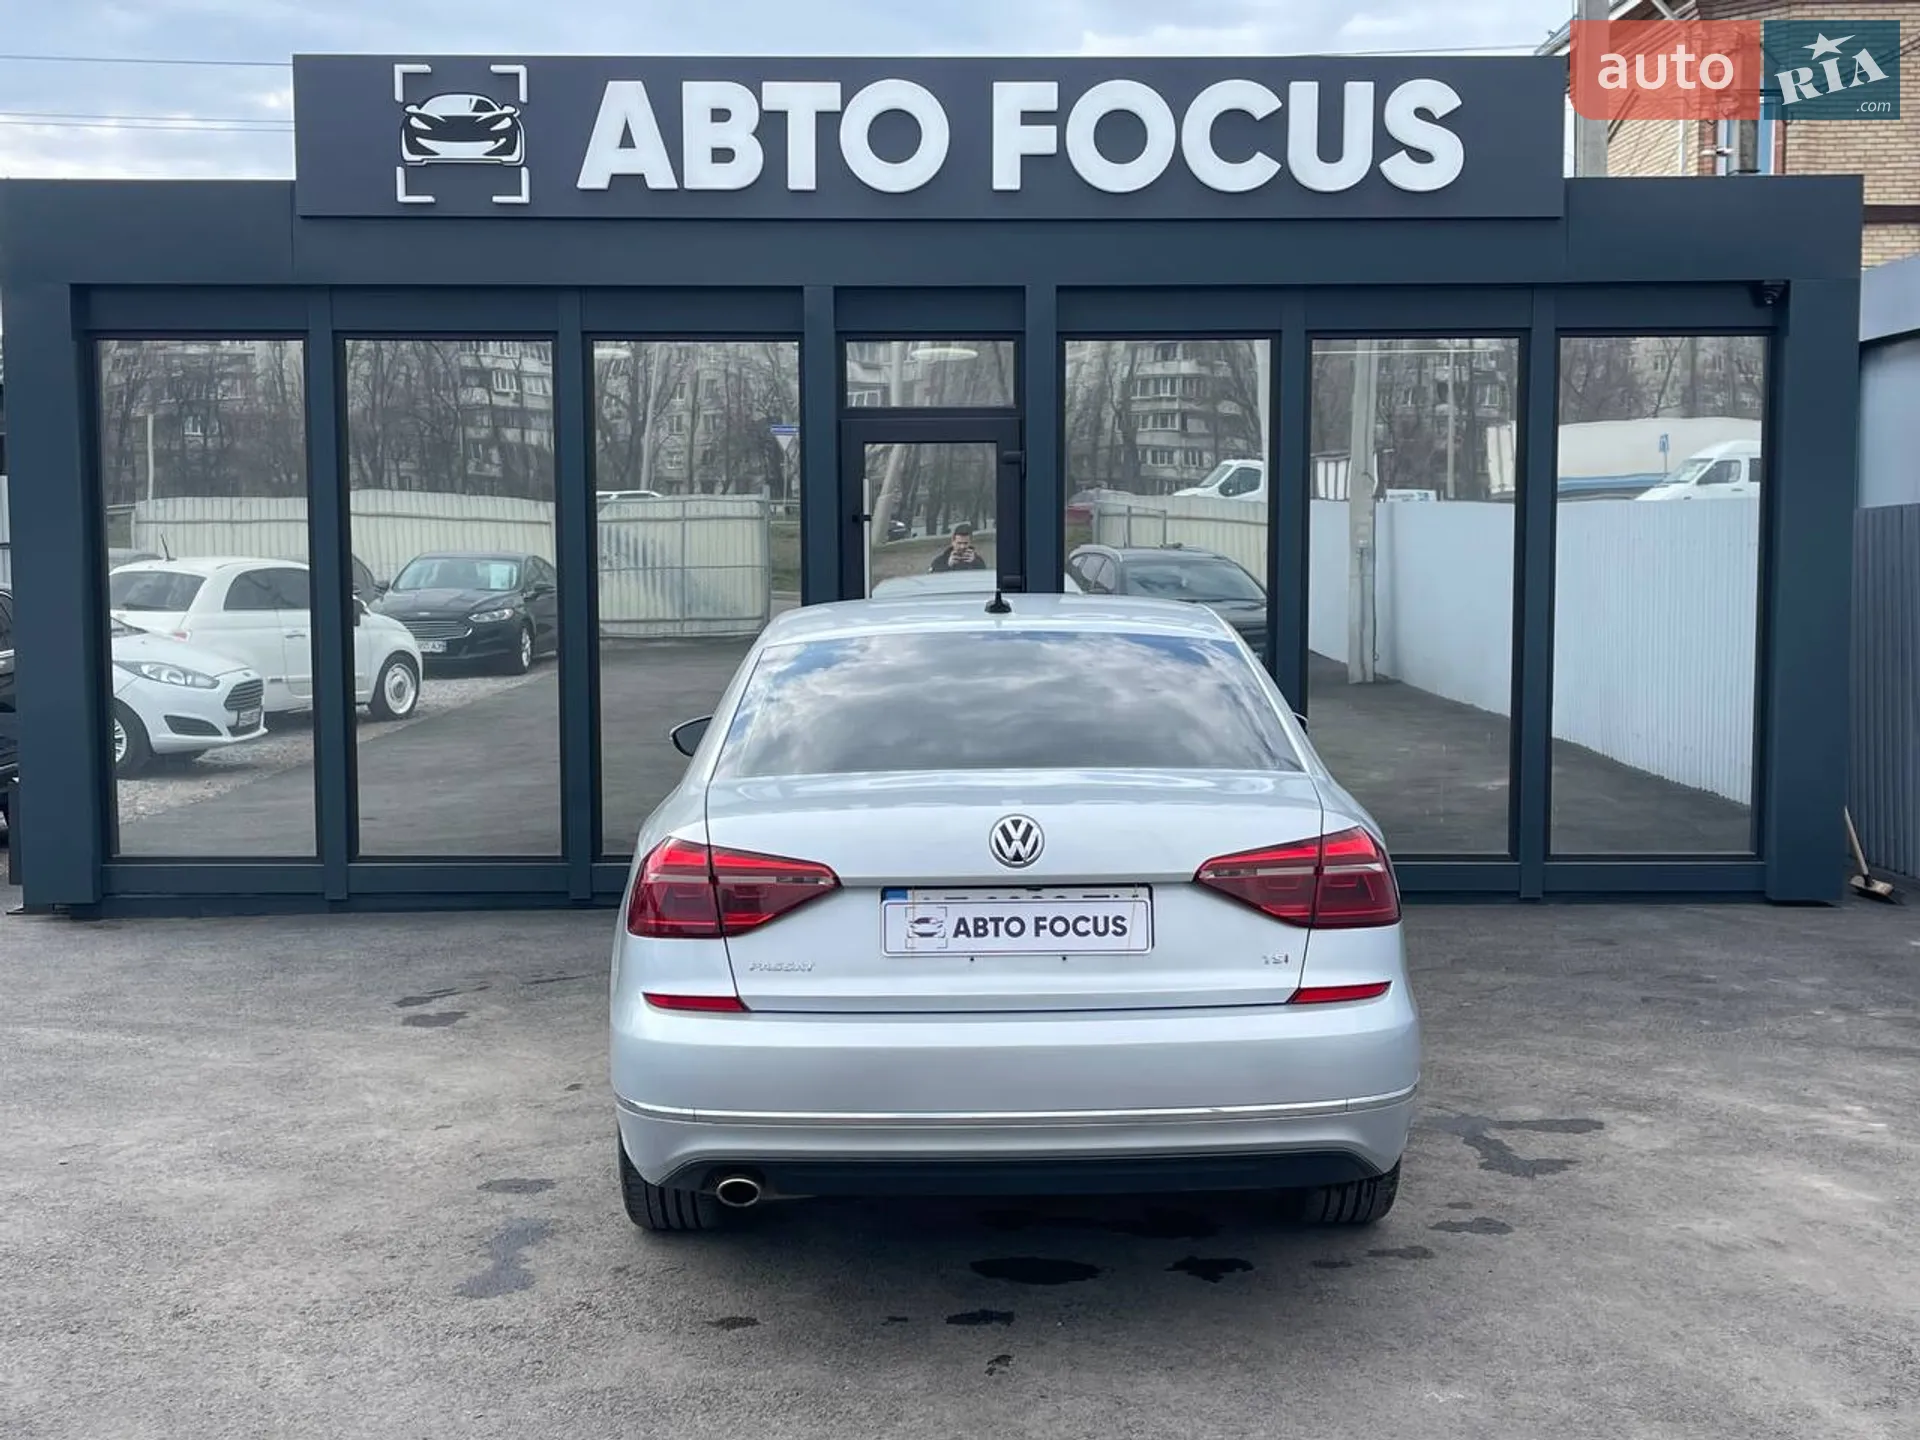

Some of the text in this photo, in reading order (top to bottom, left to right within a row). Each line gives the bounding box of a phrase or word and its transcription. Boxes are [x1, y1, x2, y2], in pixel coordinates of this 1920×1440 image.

[576, 78, 1464, 193] АВТО FOCUS
[953, 915, 1128, 938] АВТО FOCUS
